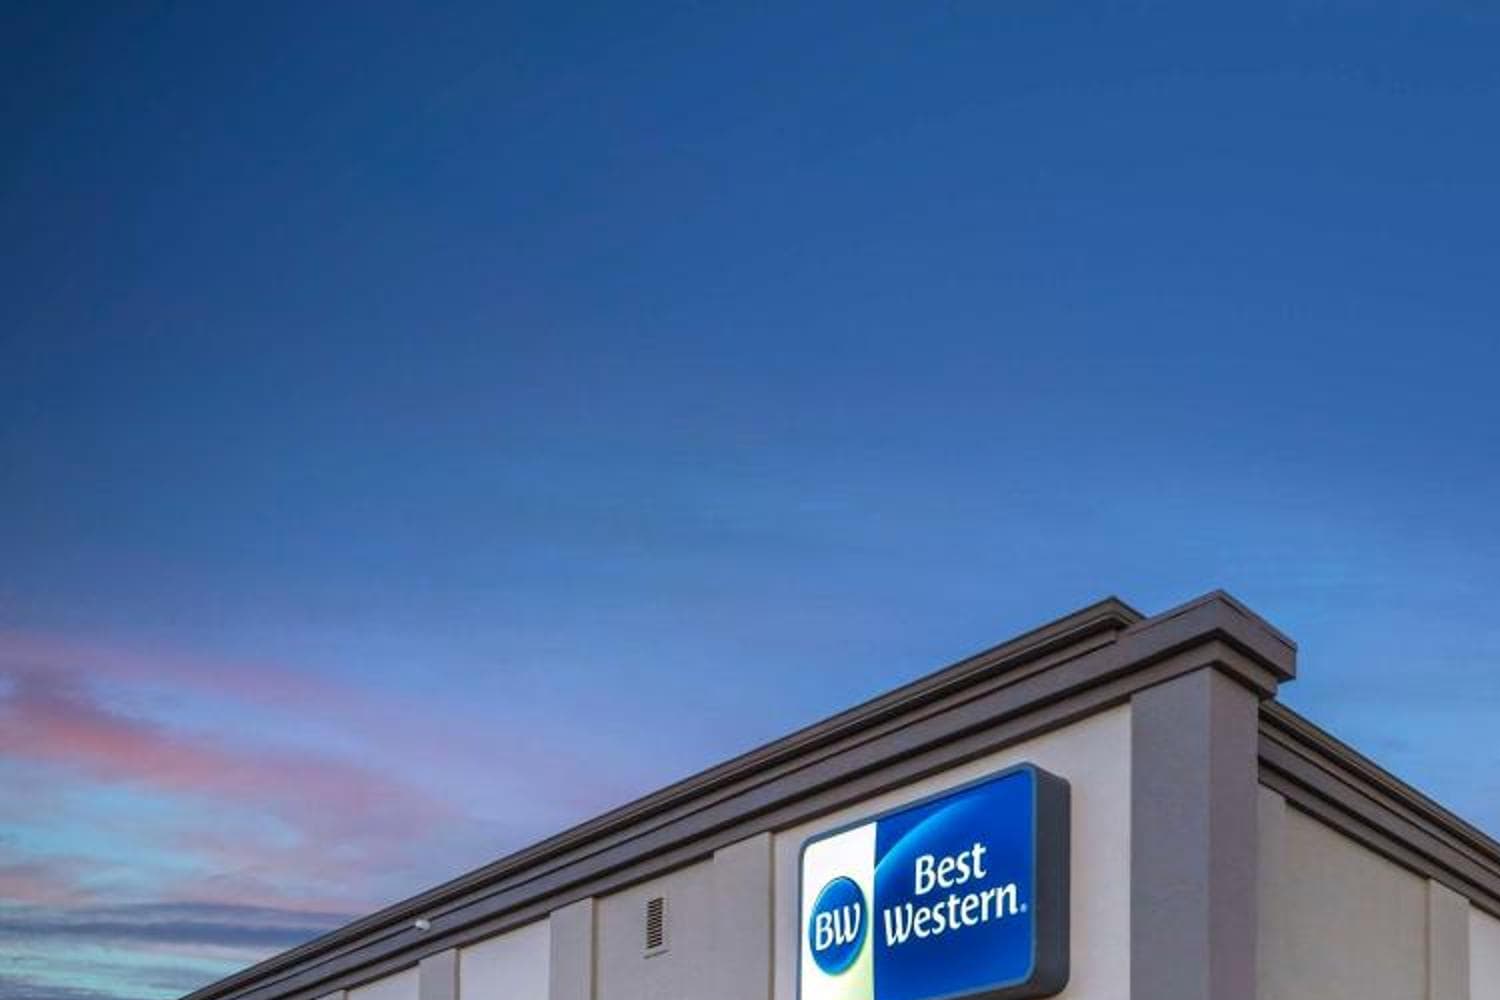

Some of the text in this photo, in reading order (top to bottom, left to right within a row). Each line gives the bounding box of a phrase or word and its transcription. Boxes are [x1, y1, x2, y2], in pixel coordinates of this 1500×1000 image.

[914, 842, 987, 896] Best
[814, 902, 861, 952] BW
[883, 882, 1019, 948] Western
